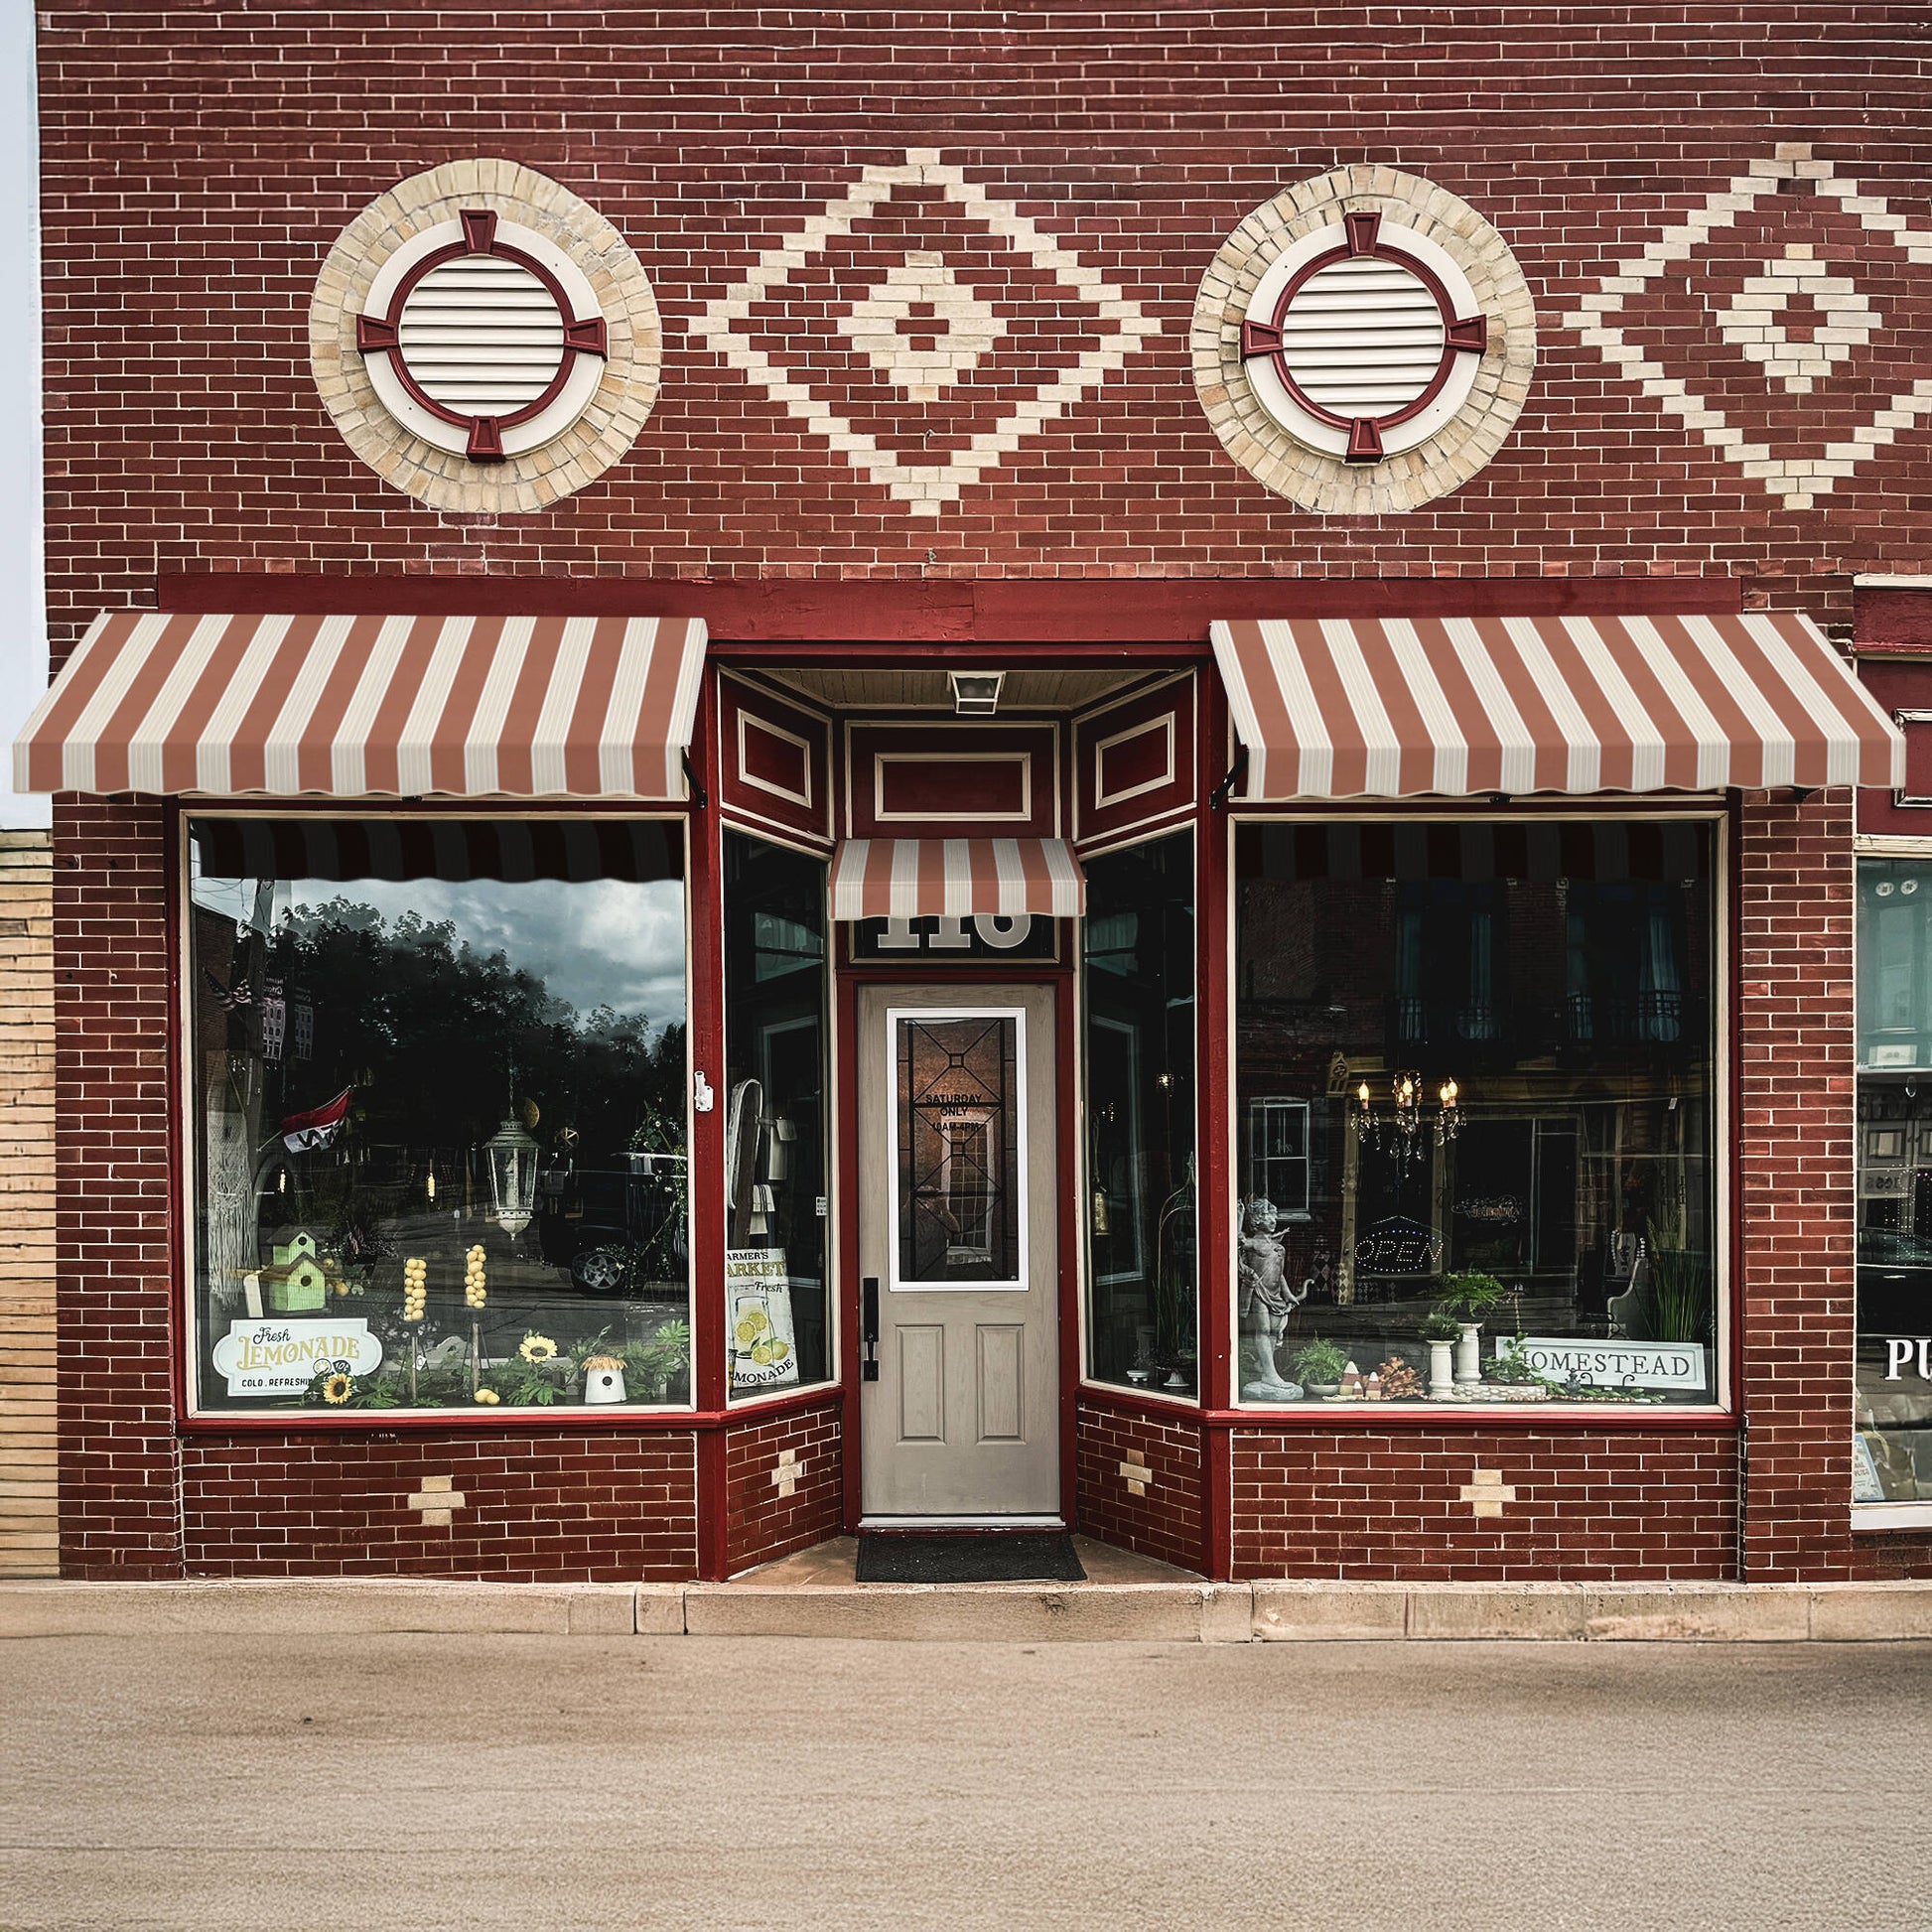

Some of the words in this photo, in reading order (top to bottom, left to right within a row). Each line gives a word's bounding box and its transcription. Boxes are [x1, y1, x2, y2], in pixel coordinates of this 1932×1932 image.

[926, 1094, 982, 1103] SATURDAY
[940, 1106, 968, 1116] ONLY
[1354, 1240, 1444, 1262] OPEN
[755, 1281, 782, 1293] Fresh
[253, 1326, 291, 1344] Fresh
[236, 1335, 359, 1371] LEMONADE
